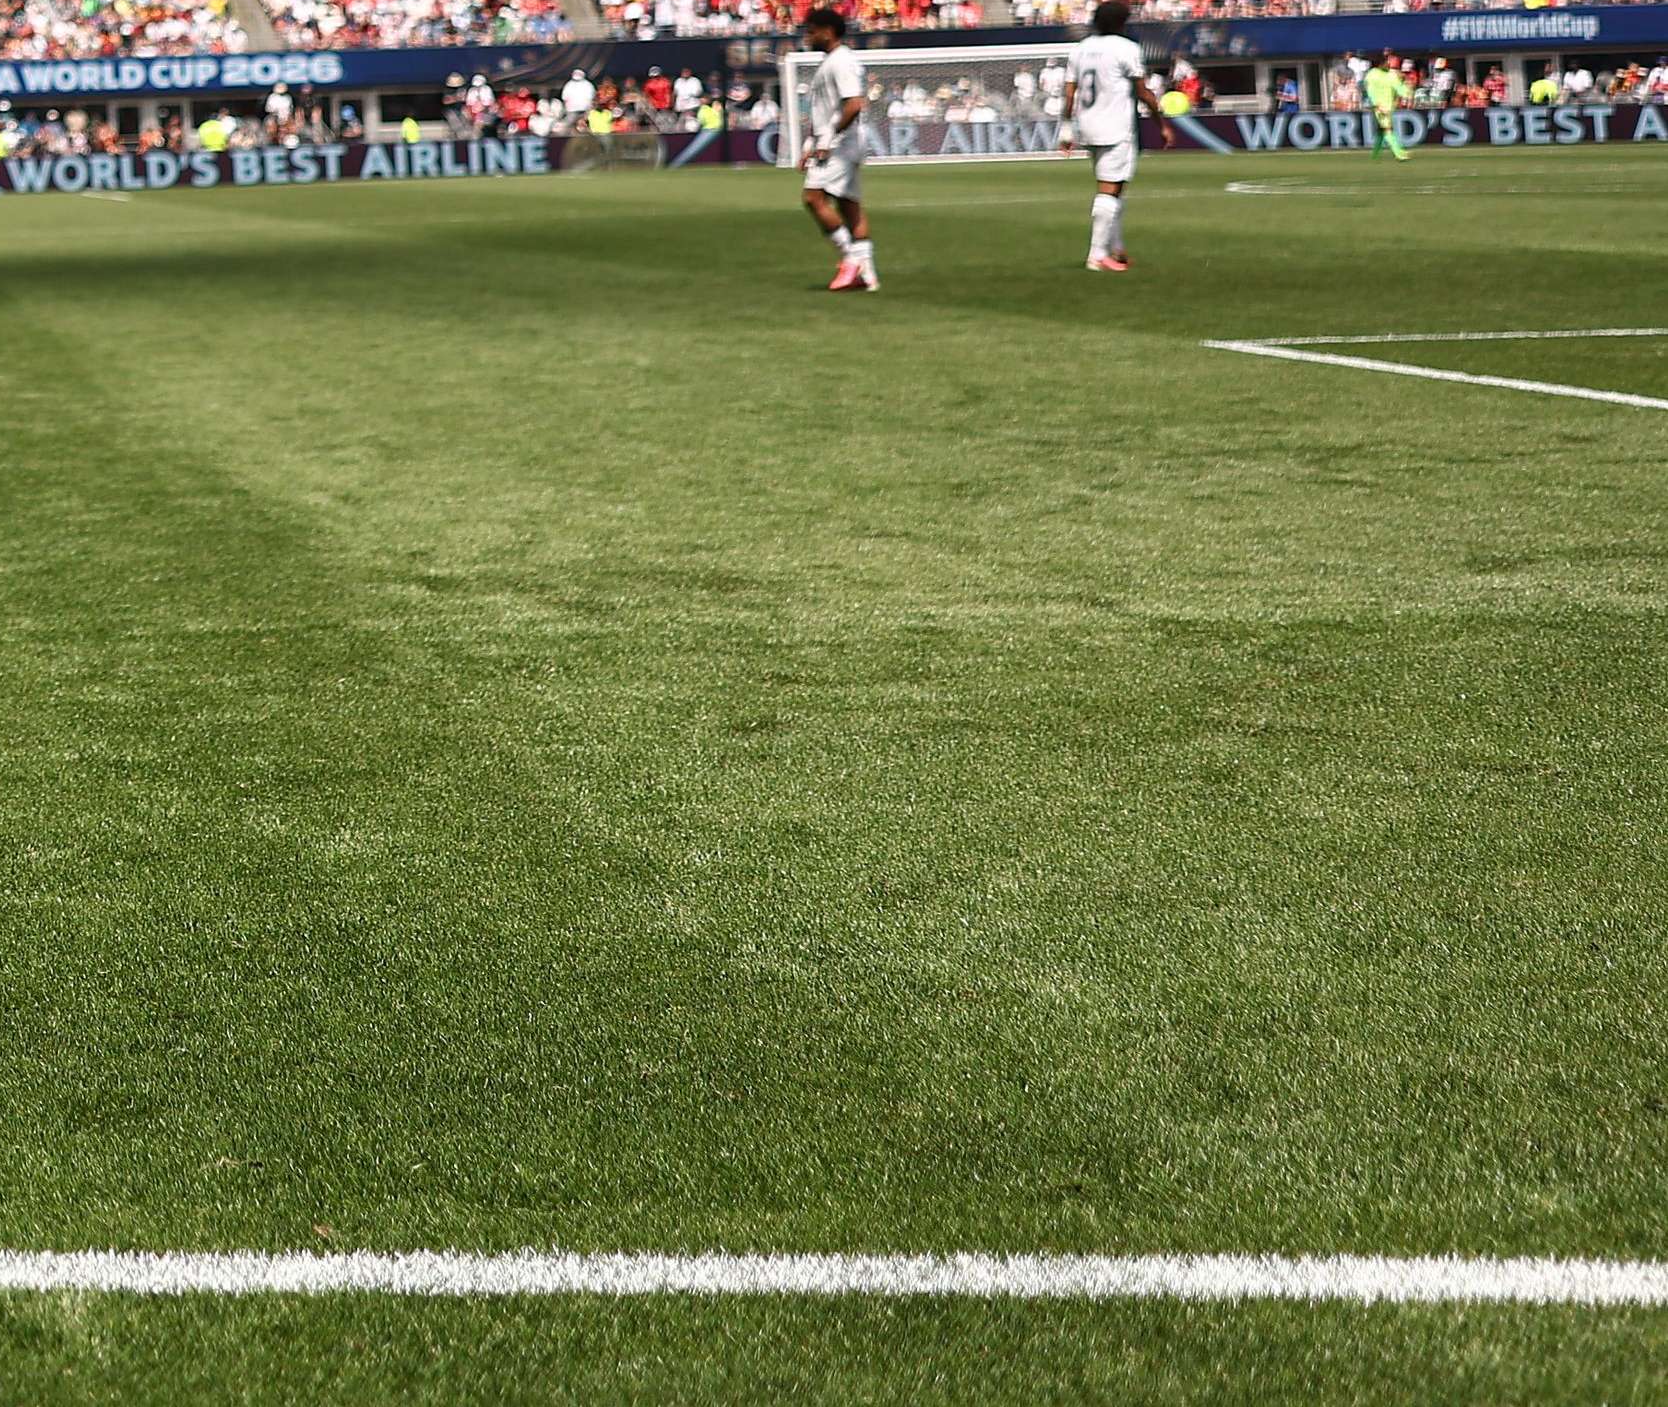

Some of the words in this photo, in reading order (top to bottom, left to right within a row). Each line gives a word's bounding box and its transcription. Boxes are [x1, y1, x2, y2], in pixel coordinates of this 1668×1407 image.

[1442, 14, 1601, 41] #FIFAWorldCup
[22, 59, 147, 93] WORLD
[149, 57, 220, 89] CUP
[221, 54, 344, 86] 2026
[1486, 104, 1614, 145] BEST
[6, 151, 219, 193] WORLD'S
[231, 144, 347, 185] BEST
[361, 136, 551, 179] AIRLINE
